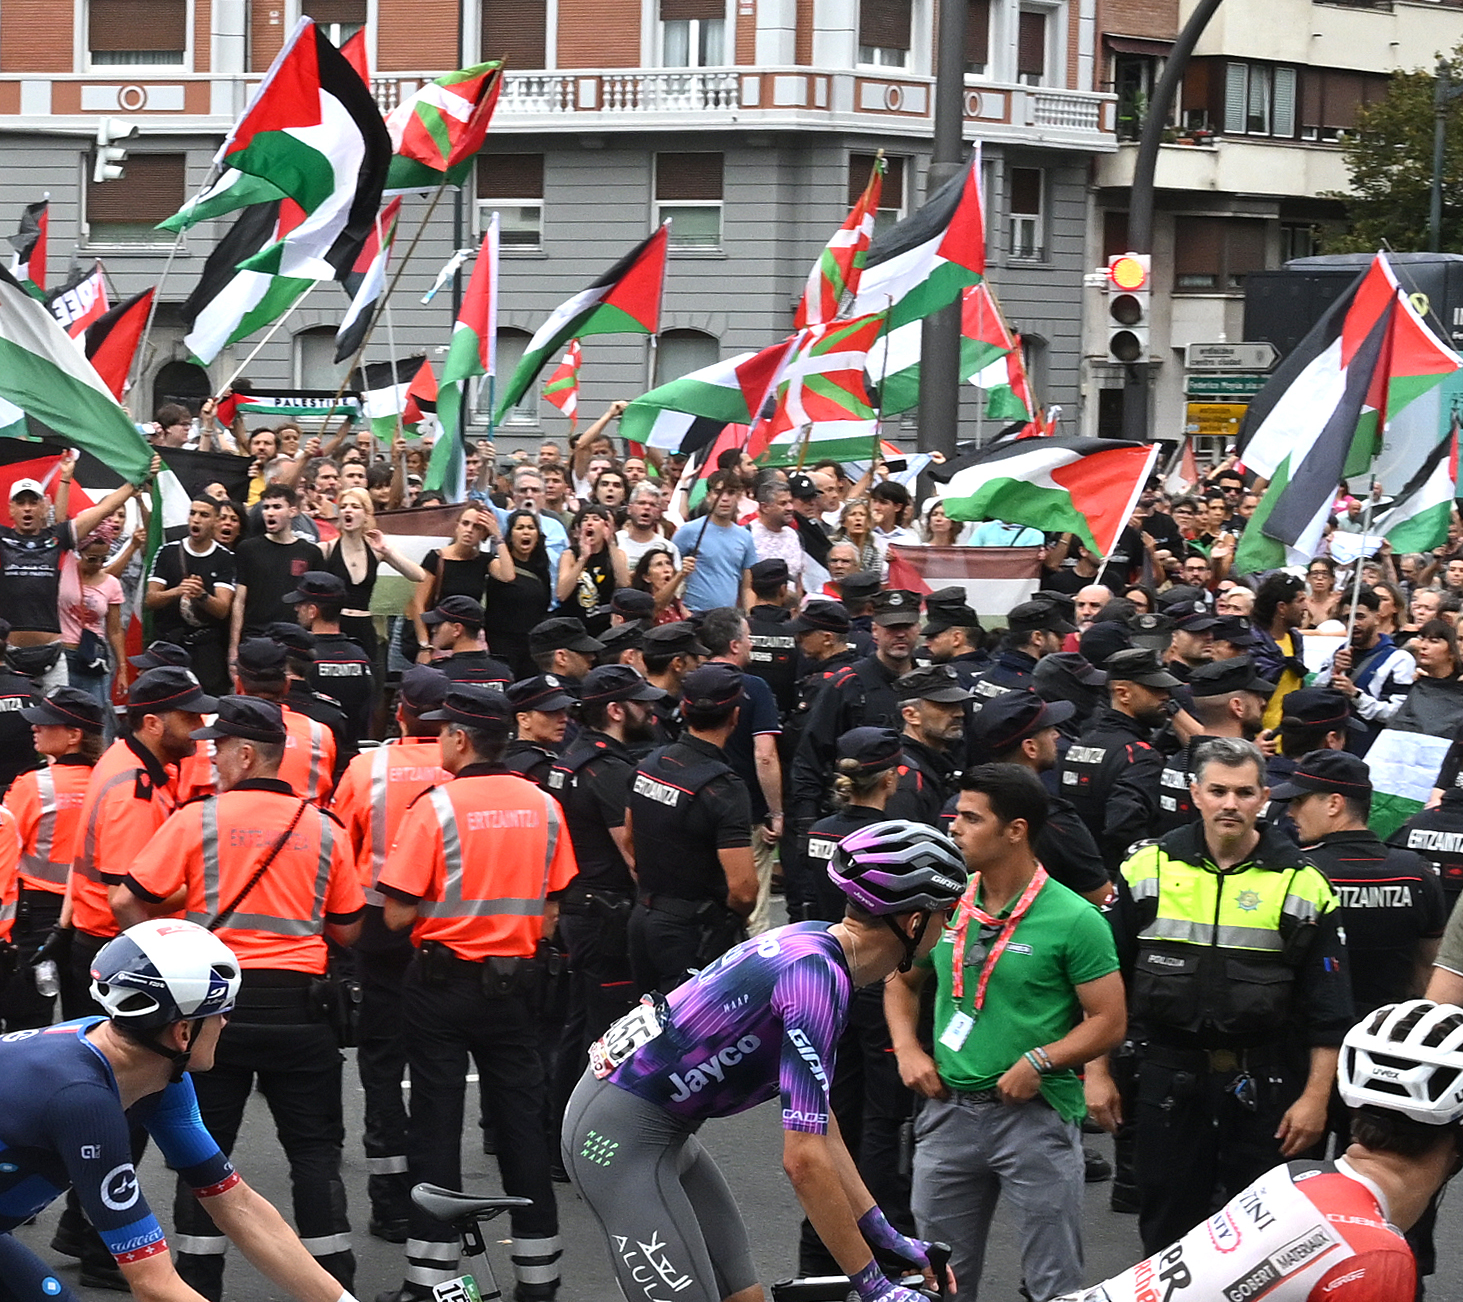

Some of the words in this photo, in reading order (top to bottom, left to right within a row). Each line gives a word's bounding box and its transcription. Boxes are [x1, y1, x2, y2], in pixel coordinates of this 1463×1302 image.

[466, 810, 540, 831] ERTZAINTZA
[930, 874, 962, 892] GIANT
[853, 891, 875, 908] Jayco
[1334, 886, 1413, 908] RTZAINTZA
[723, 993, 750, 1014] MAAP
[668, 1033, 763, 1104] Jayco
[786, 1028, 830, 1095] GIAN
[1372, 1067, 1400, 1080] uvex
[782, 1108, 829, 1124] CADE
[583, 1139, 615, 1159] MAAP
[586, 1129, 620, 1150] MAAP
[580, 1149, 611, 1168] MAAP
[1238, 1191, 1277, 1232] TINI
[1212, 1212, 1233, 1240] NTY
[110, 1227, 164, 1255] Wilier
